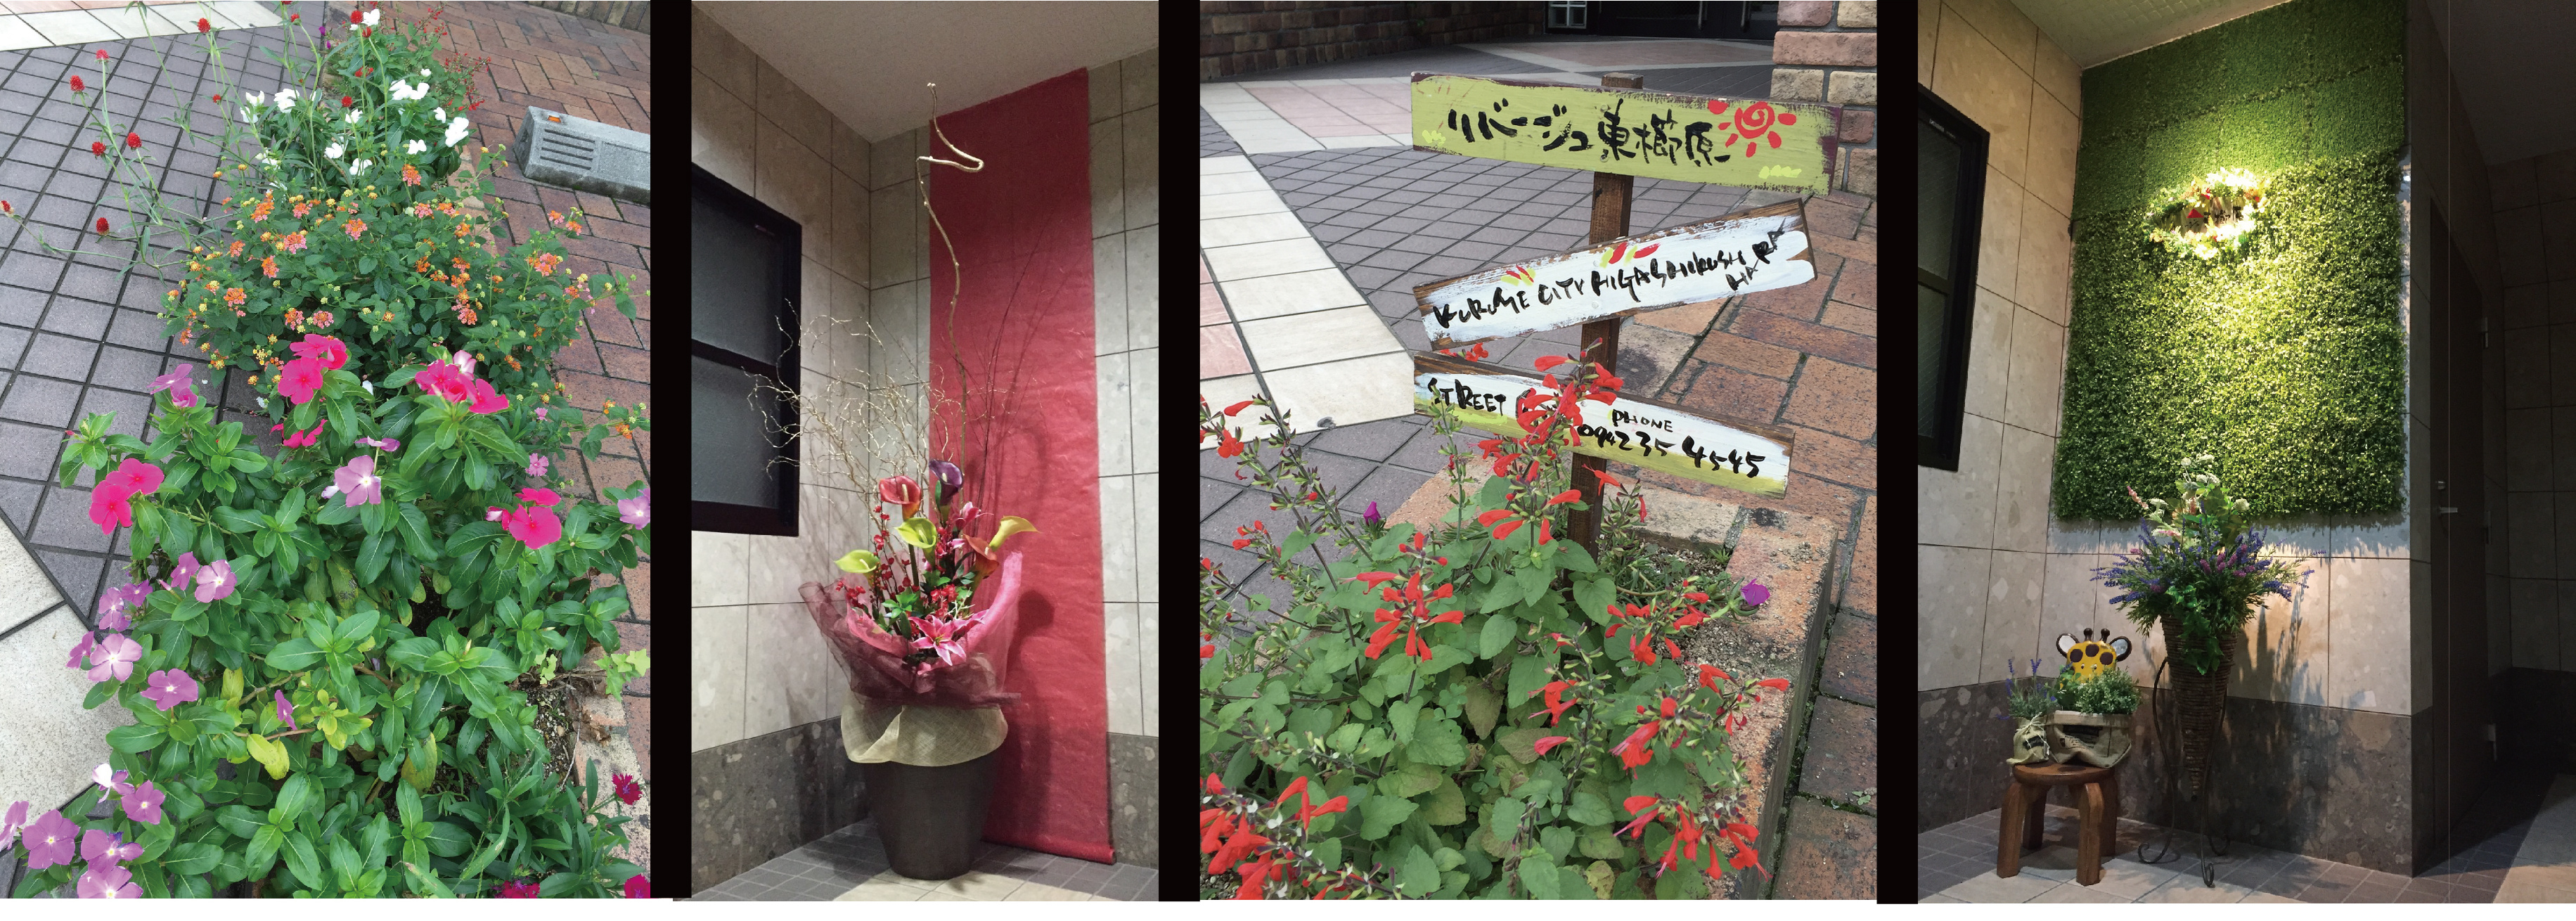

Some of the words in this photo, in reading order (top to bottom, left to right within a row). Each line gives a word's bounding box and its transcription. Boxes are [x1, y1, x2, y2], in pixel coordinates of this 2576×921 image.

[1432, 287, 1531, 329] KURUME
[1538, 277, 1585, 305] CITY
[1427, 377, 1507, 416] STREET
[1611, 408, 1674, 432] PHONE
[1682, 435, 1766, 479] 4545
